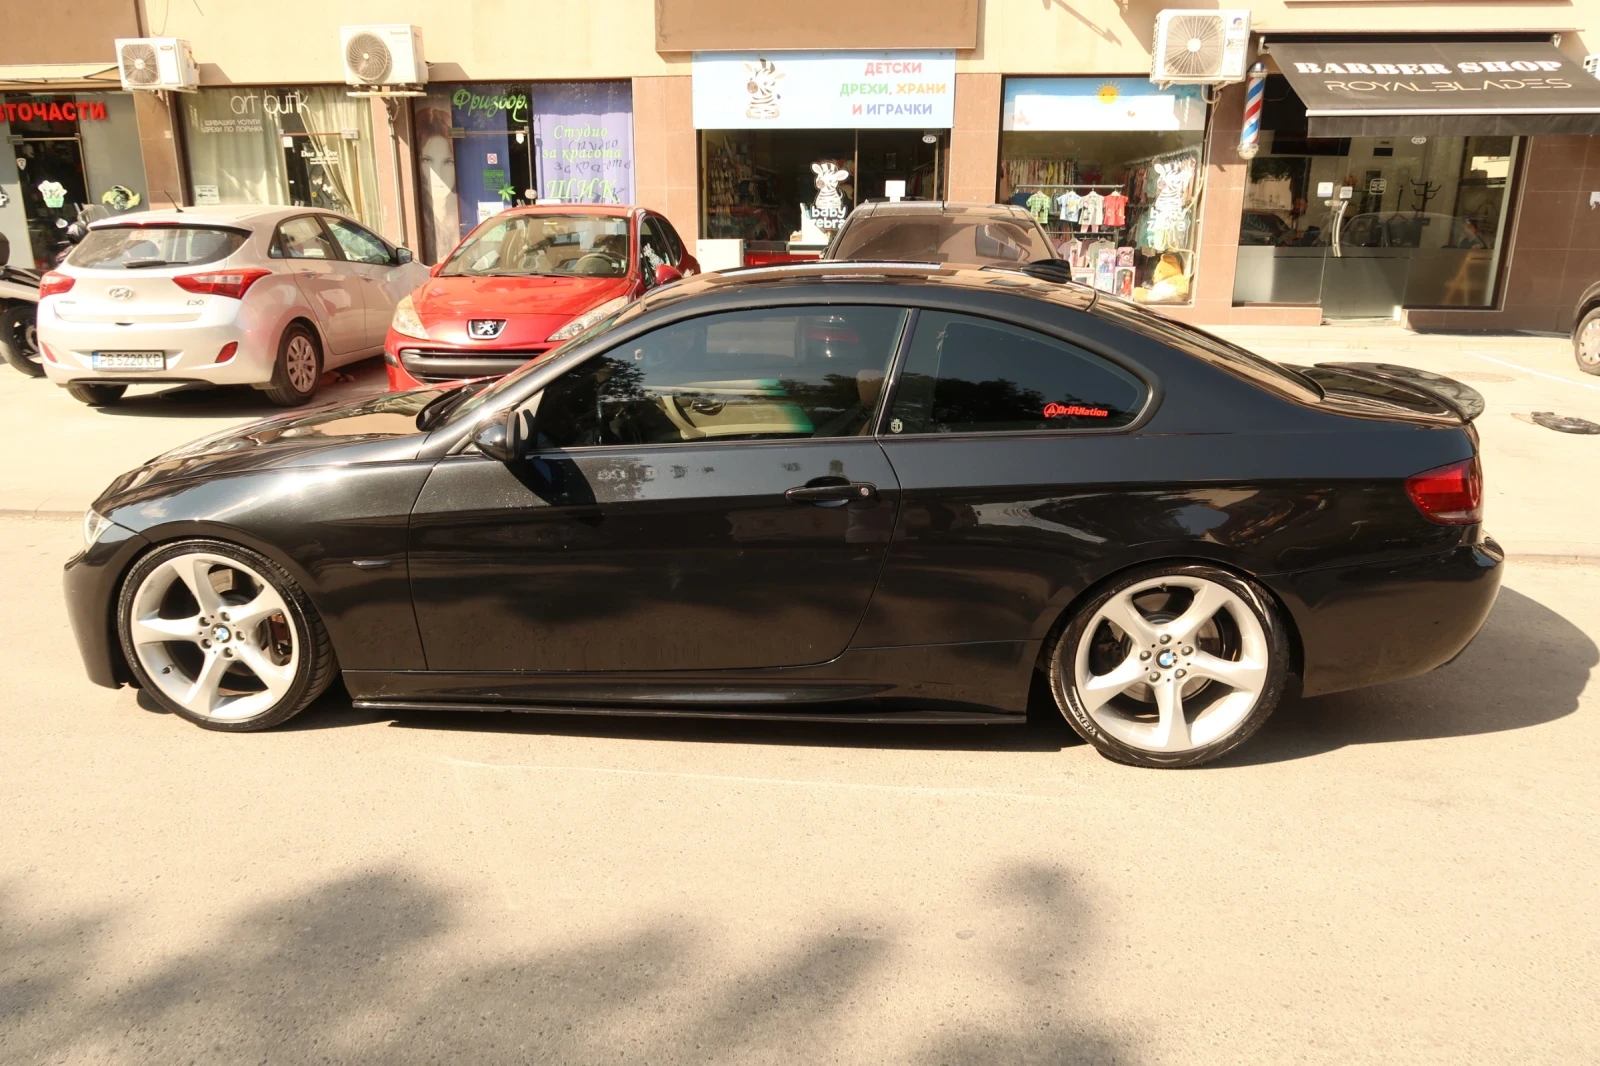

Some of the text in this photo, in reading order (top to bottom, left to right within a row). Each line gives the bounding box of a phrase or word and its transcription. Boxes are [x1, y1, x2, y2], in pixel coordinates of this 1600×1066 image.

[864, 62, 922, 76] ДЕТСКИ
[1292, 61, 1563, 75] BARBER SHOP
[840, 83, 946, 97] ДРЕХИ, ХРАНИ
[230, 90, 310, 115] art butik
[852, 104, 933, 115] И ИГРАЧКИ
[553, 123, 608, 142] Студио
[542, 149, 622, 163] за красота
[546, 178, 621, 202] ШИК
[811, 205, 847, 218] baby
[813, 217, 846, 229] ebra
[117, 354, 143, 366] 5220
